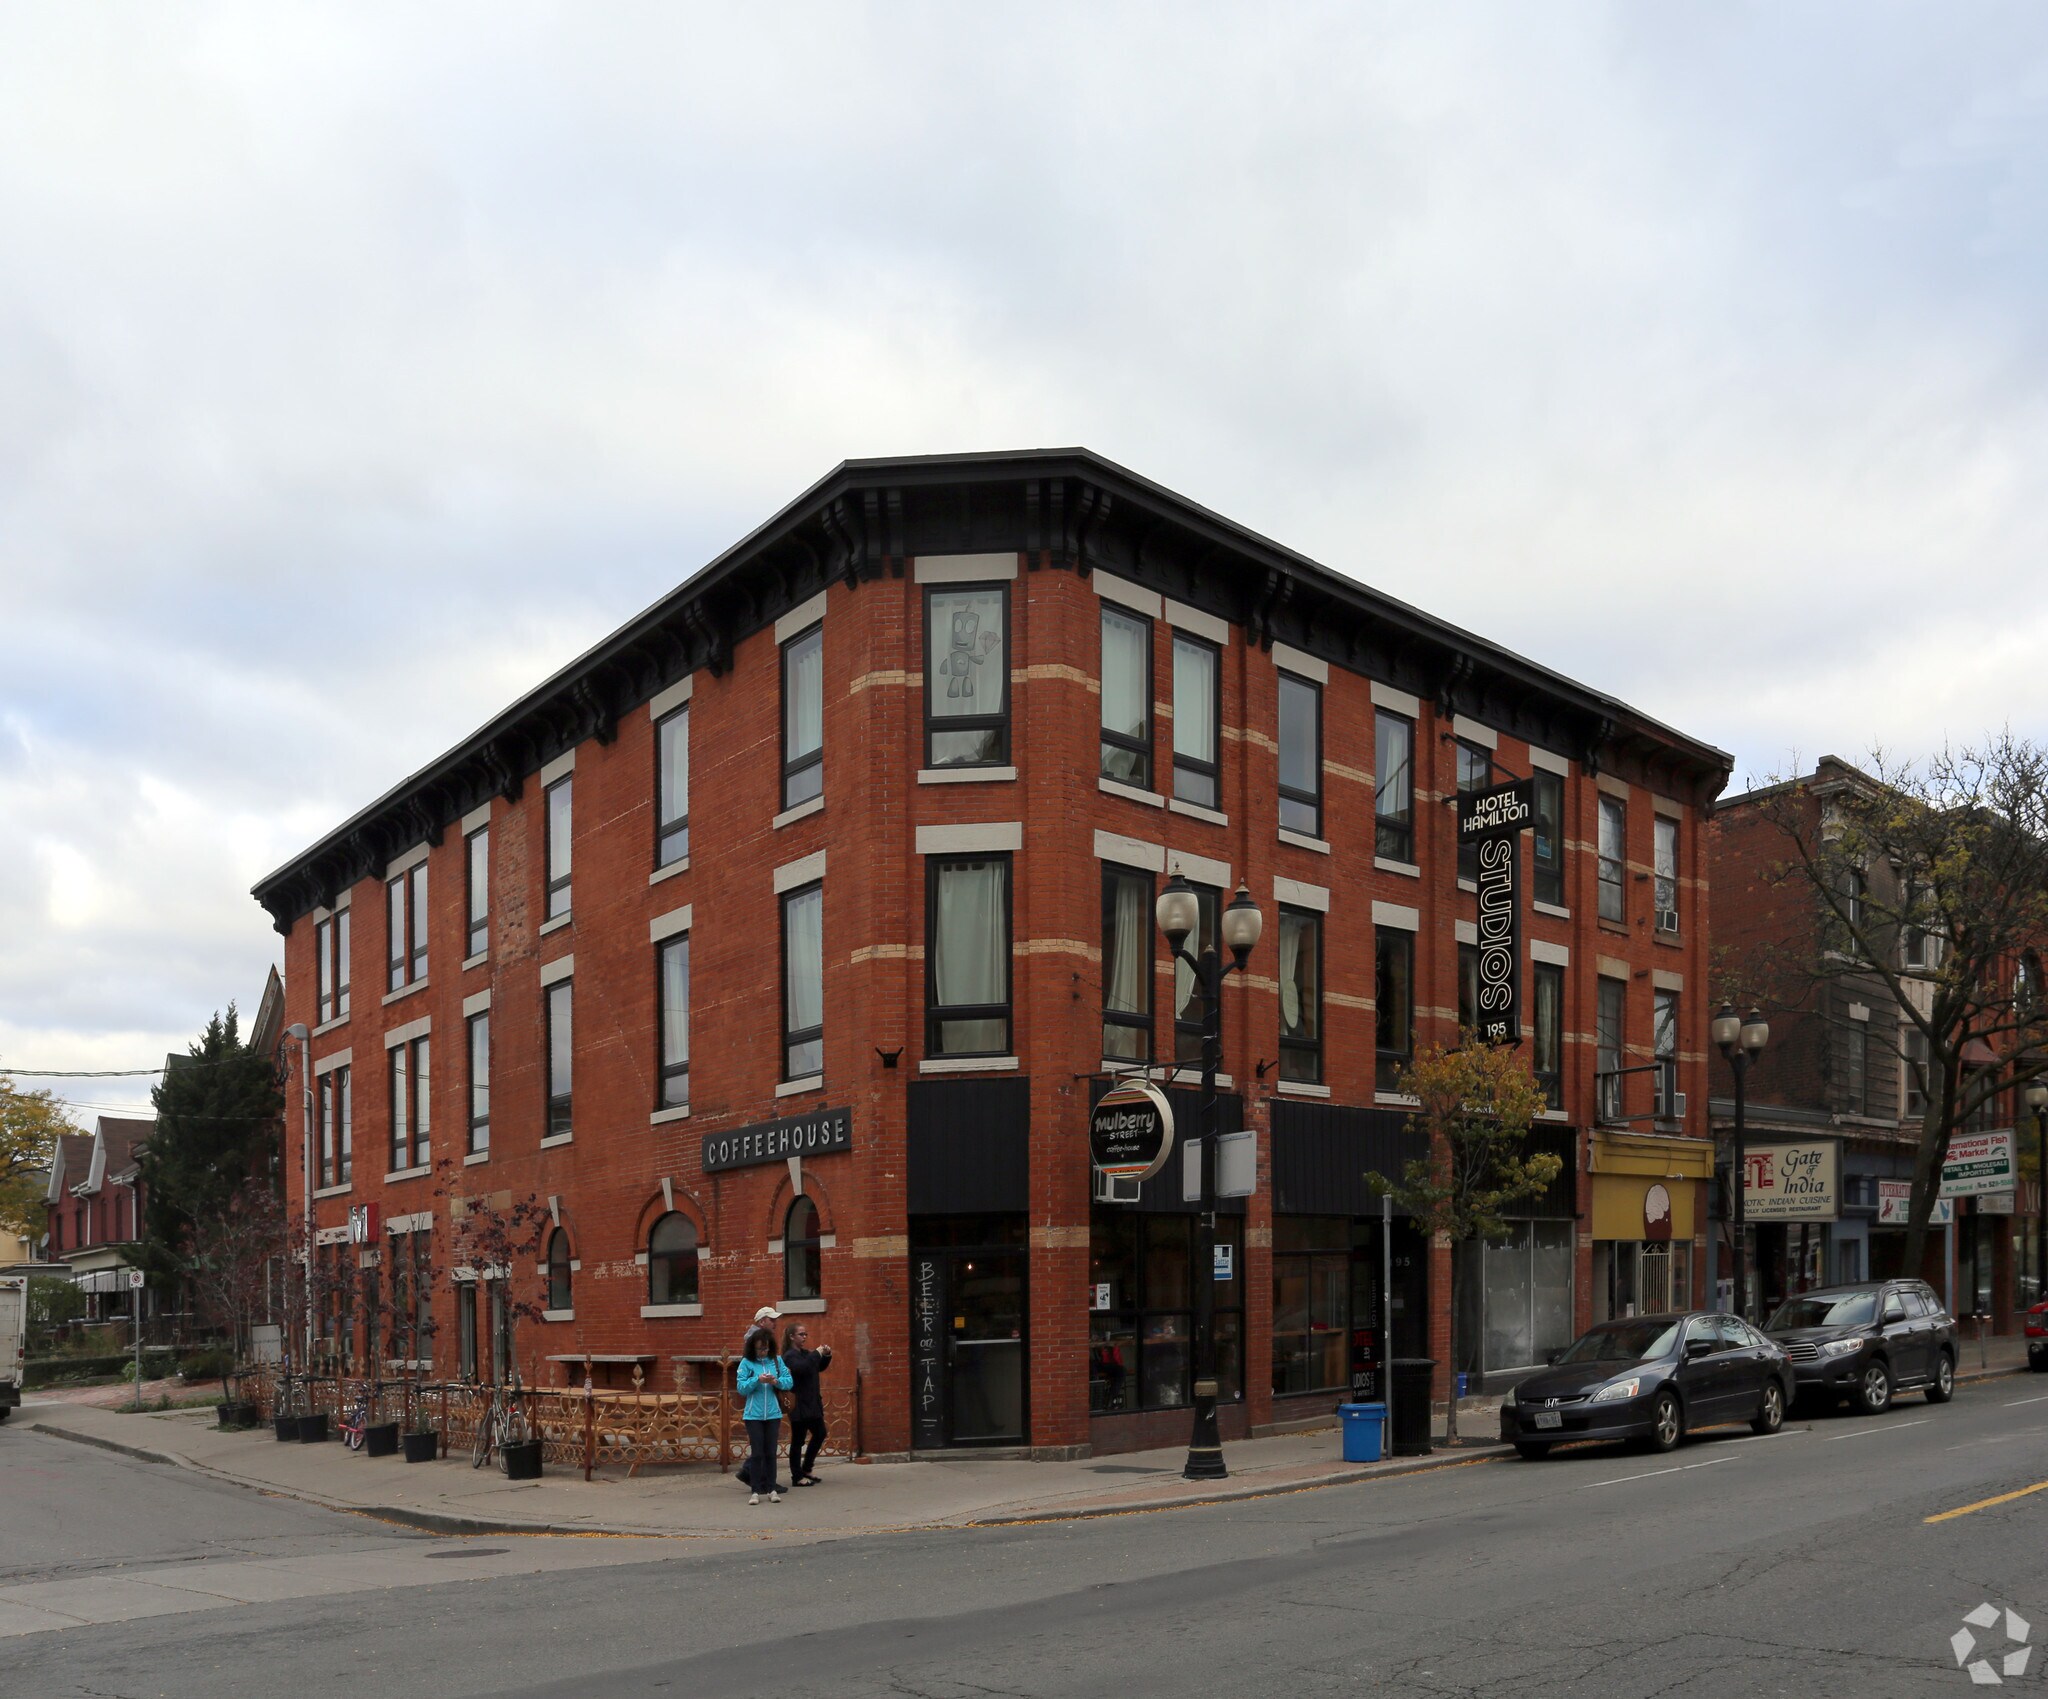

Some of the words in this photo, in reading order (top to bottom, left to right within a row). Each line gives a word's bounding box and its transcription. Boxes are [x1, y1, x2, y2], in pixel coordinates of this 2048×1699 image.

[1475, 791, 1518, 815] HOTEL
[1463, 803, 1529, 833] HAMILTON
[1480, 839, 1512, 1011] STUDIOS
[1487, 1022, 1507, 1036] 195
[1095, 1112, 1156, 1134] Mulberry
[708, 1118, 845, 1164] COFFEEHOUSE
[1109, 1129, 1139, 1140] STREET
[1946, 1138, 1989, 1150] ternational
[1991, 1136, 2008, 1145] Fish
[1959, 1147, 1989, 1158] Market
[1781, 1149, 1824, 1177] Gate
[1973, 1160, 2008, 1170] WHOLESALE
[1958, 1168, 1995, 1178] IMPORTERS
[1784, 1176, 1825, 1194] India
[1769, 1197, 1797, 1206] INDIAN
[1799, 1195, 1833, 1205] CUISINE
[1789, 1204, 1822, 1212] RESTAURANT
[920, 1262, 935, 1332] BEER
[920, 1358, 936, 1412] TAP
[1353, 1372, 1370, 1388] UDIOS
